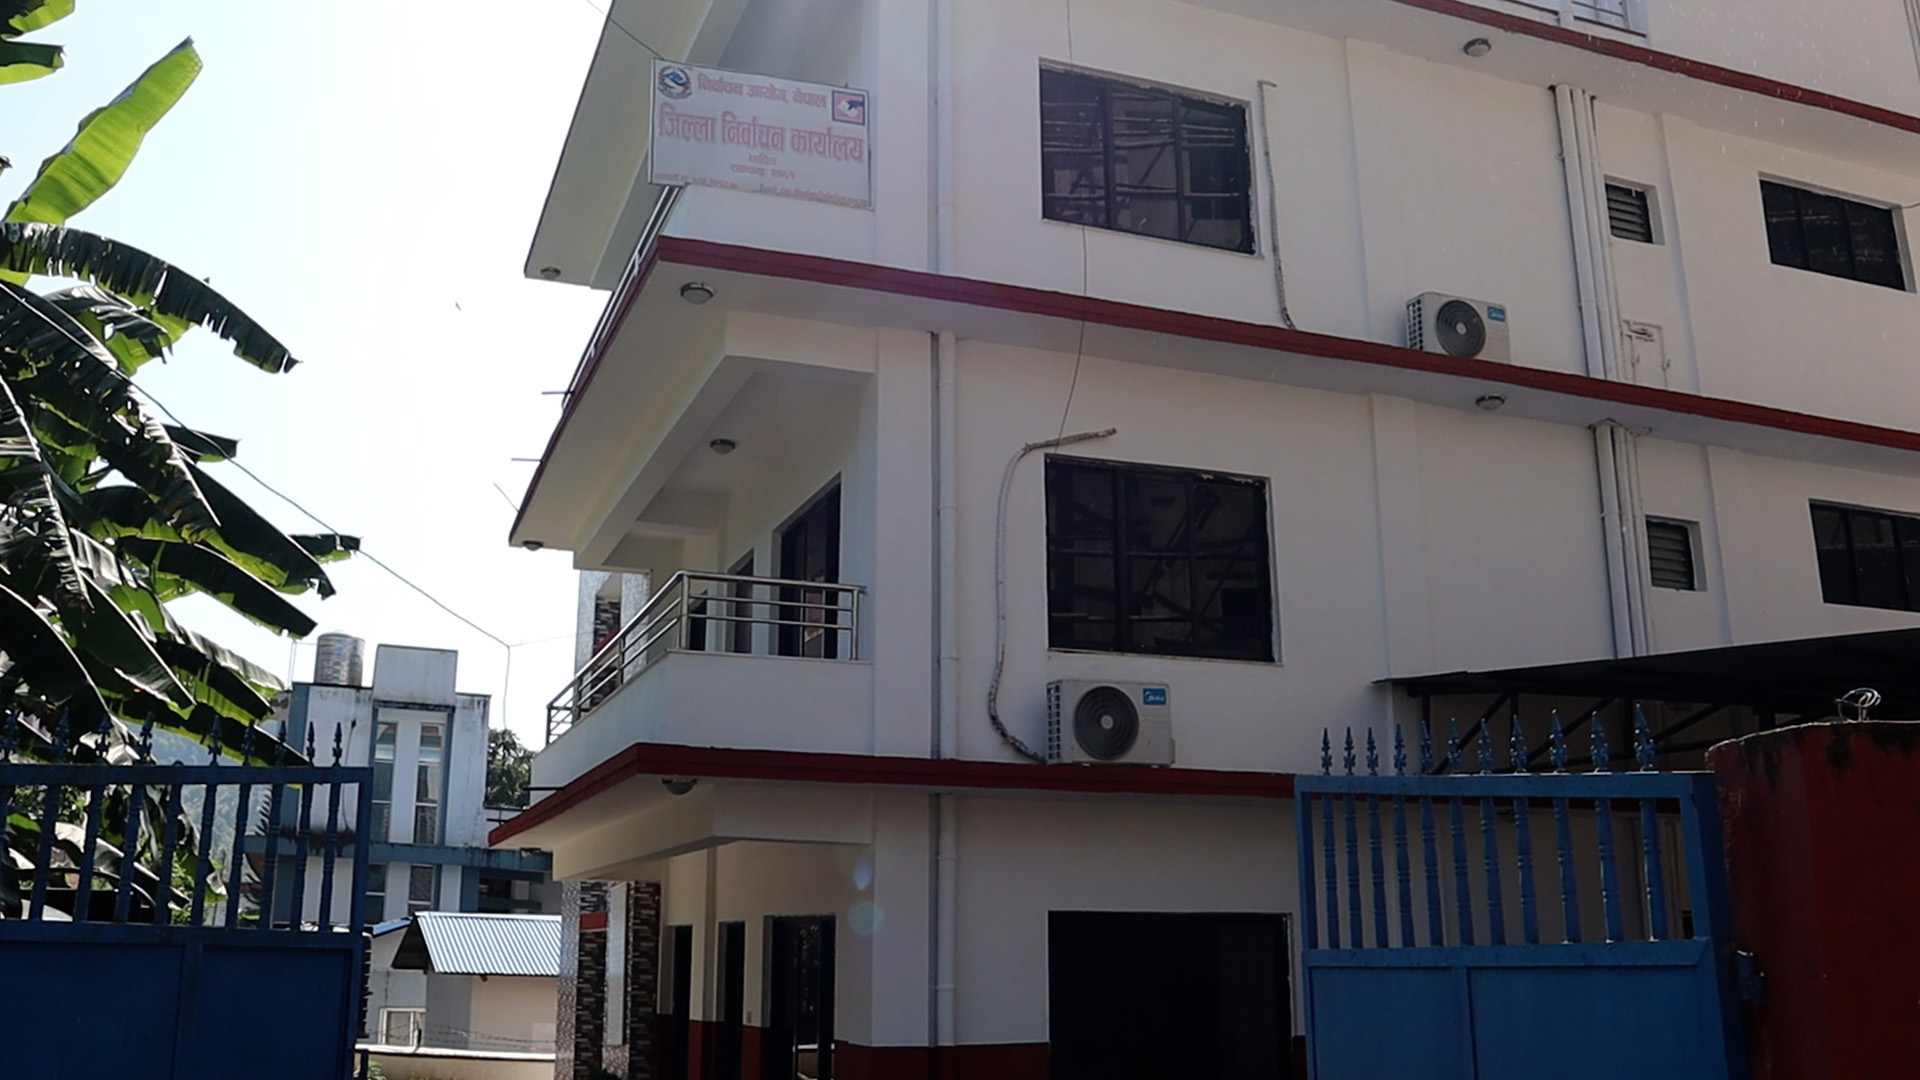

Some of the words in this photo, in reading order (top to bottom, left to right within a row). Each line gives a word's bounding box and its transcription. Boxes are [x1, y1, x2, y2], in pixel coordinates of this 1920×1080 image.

[658, 102, 715, 142] जिल्ला
[721, 110, 784, 151] निर्वाचन
[791, 127, 864, 163] कार्यालय
